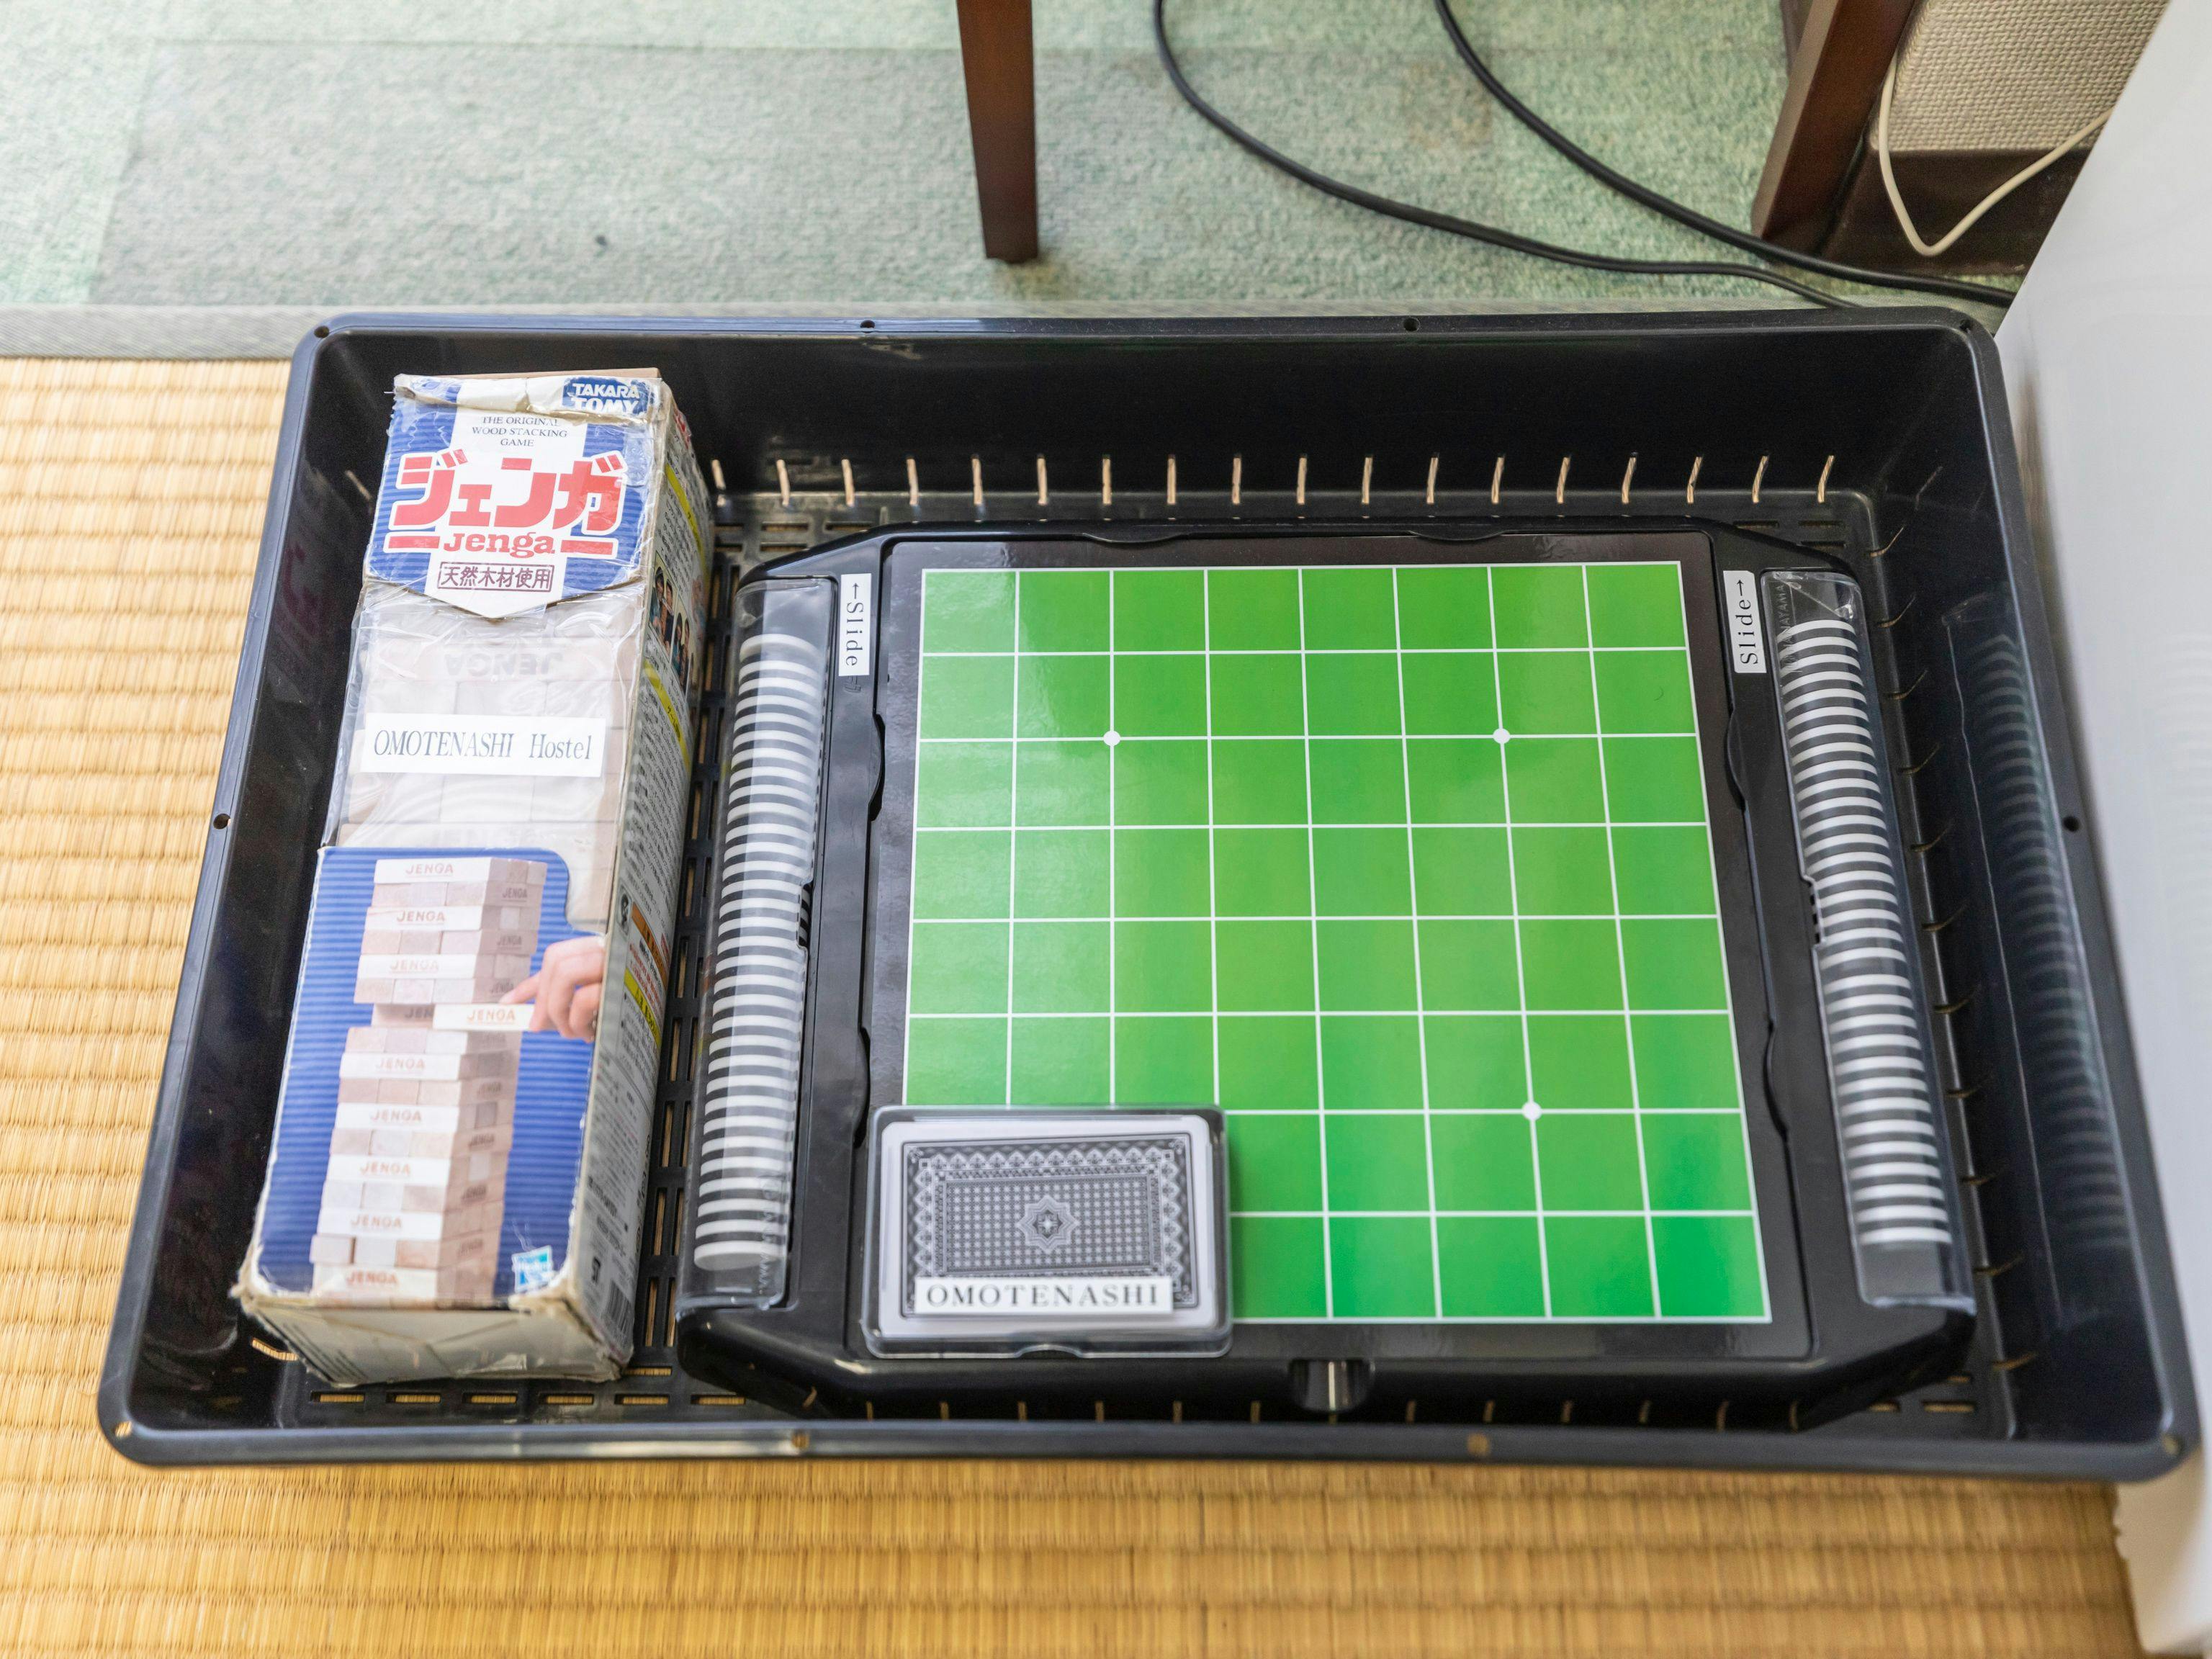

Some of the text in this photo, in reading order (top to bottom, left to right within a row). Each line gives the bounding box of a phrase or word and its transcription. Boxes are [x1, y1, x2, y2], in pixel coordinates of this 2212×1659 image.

[572, 383, 640, 399] TAKARA
[571, 397, 639, 414] TOMY
[506, 416, 560, 427] ORIGINAL
[472, 426, 568, 438] WOOD STACKING
[500, 438, 534, 446] GAME
[393, 449, 624, 531] ジェンガ
[444, 531, 555, 559] Jenga
[441, 566, 552, 589] 天然木材使用
[845, 602, 864, 666] Slide
[1735, 598, 1758, 665] Slide
[373, 729, 593, 760] OMOTENASHI Hostel
[405, 863, 454, 874] JENGA
[397, 911, 445, 922] JENGA
[467, 1009, 516, 1021] JENGA
[927, 1284, 1159, 1308] OMOTENASHI
